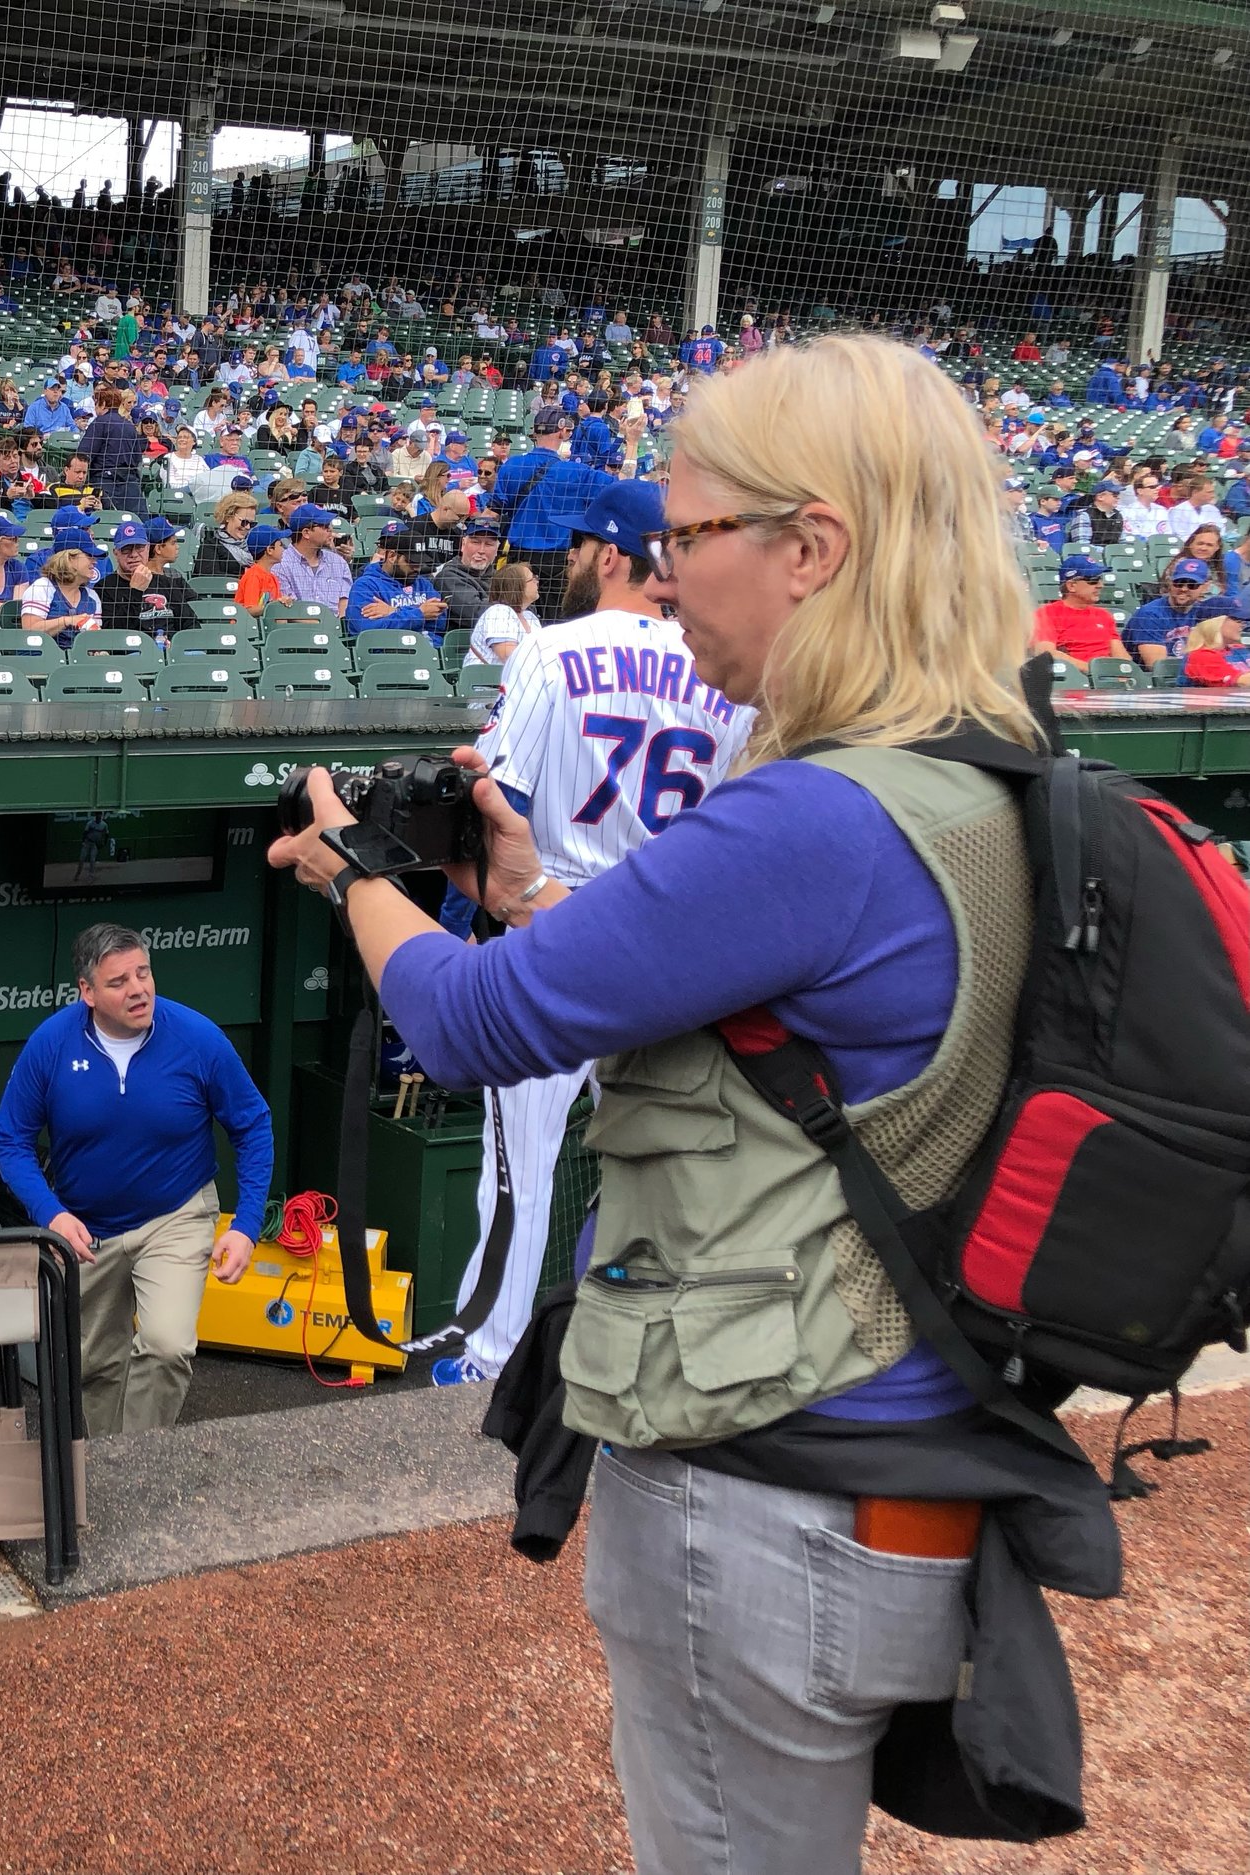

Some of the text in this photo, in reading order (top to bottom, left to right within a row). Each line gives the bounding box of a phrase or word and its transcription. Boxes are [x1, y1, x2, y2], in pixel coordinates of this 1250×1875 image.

[192, 160, 209, 174] 210
[191, 181, 209, 195] 209
[706, 196, 723, 209] 209
[705, 216, 721, 229] 208
[695, 349, 712, 364] 44
[571, 712, 718, 836] 76
